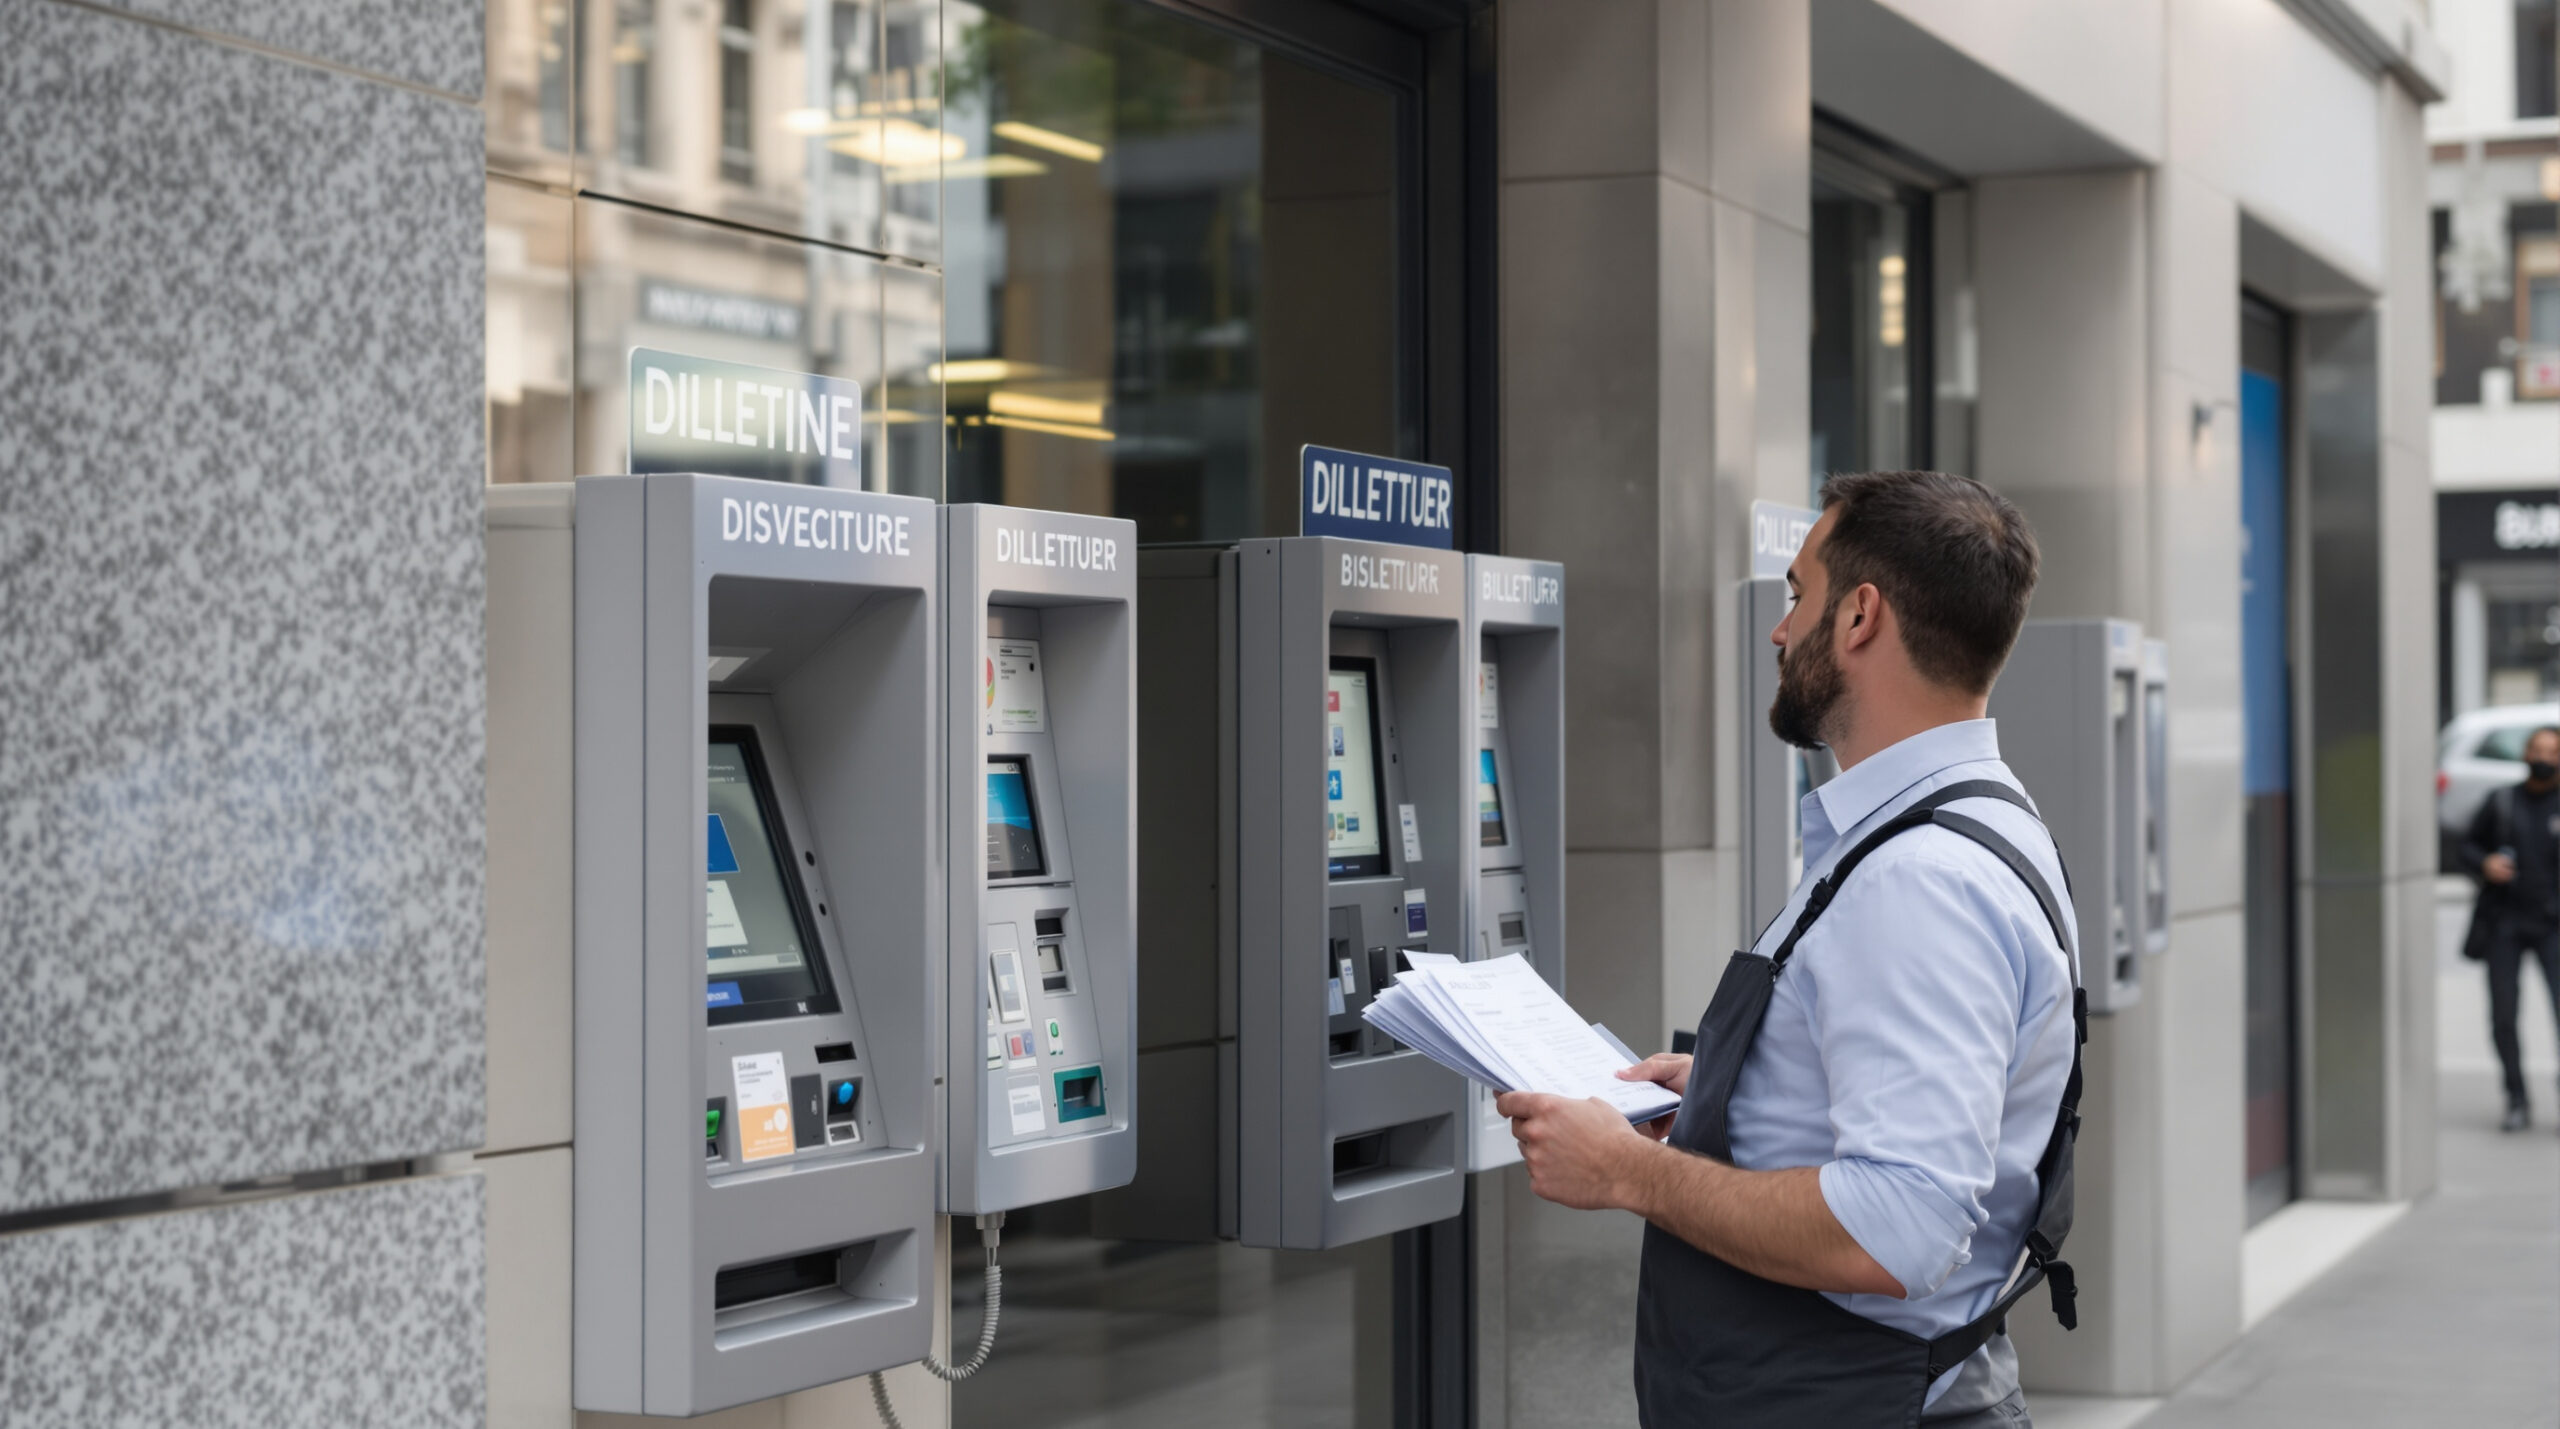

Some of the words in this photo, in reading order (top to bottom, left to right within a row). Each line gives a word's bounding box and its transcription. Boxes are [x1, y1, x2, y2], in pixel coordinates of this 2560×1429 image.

[645, 366, 853, 460] DILLETINE
[722, 497, 910, 556] DISVECITURE
[1312, 460, 1451, 529] DILLETTUER
